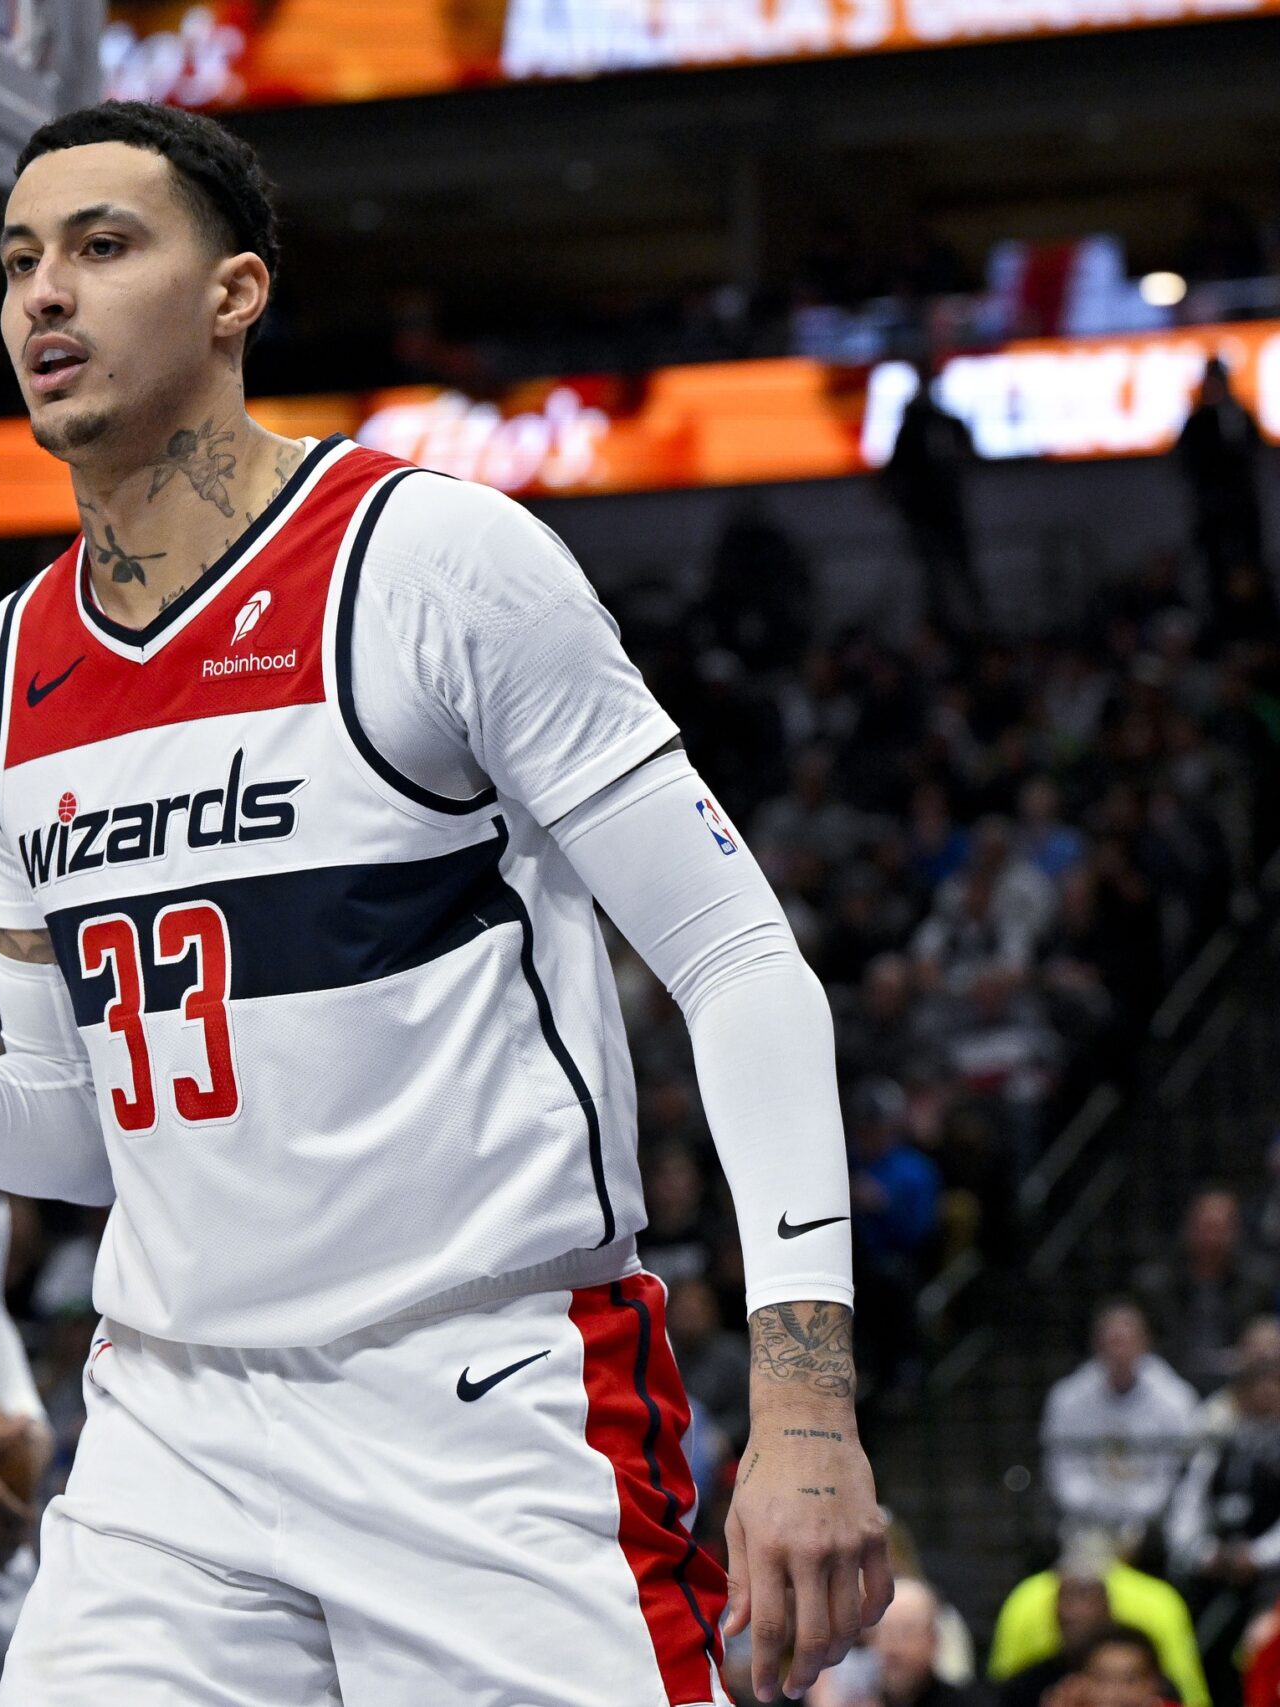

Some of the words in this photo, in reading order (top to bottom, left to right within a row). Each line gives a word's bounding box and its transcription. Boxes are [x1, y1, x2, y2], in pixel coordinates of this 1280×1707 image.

[202, 649, 296, 678] Robinhood
[19, 747, 308, 889] wizards
[80, 903, 241, 1135] 33
